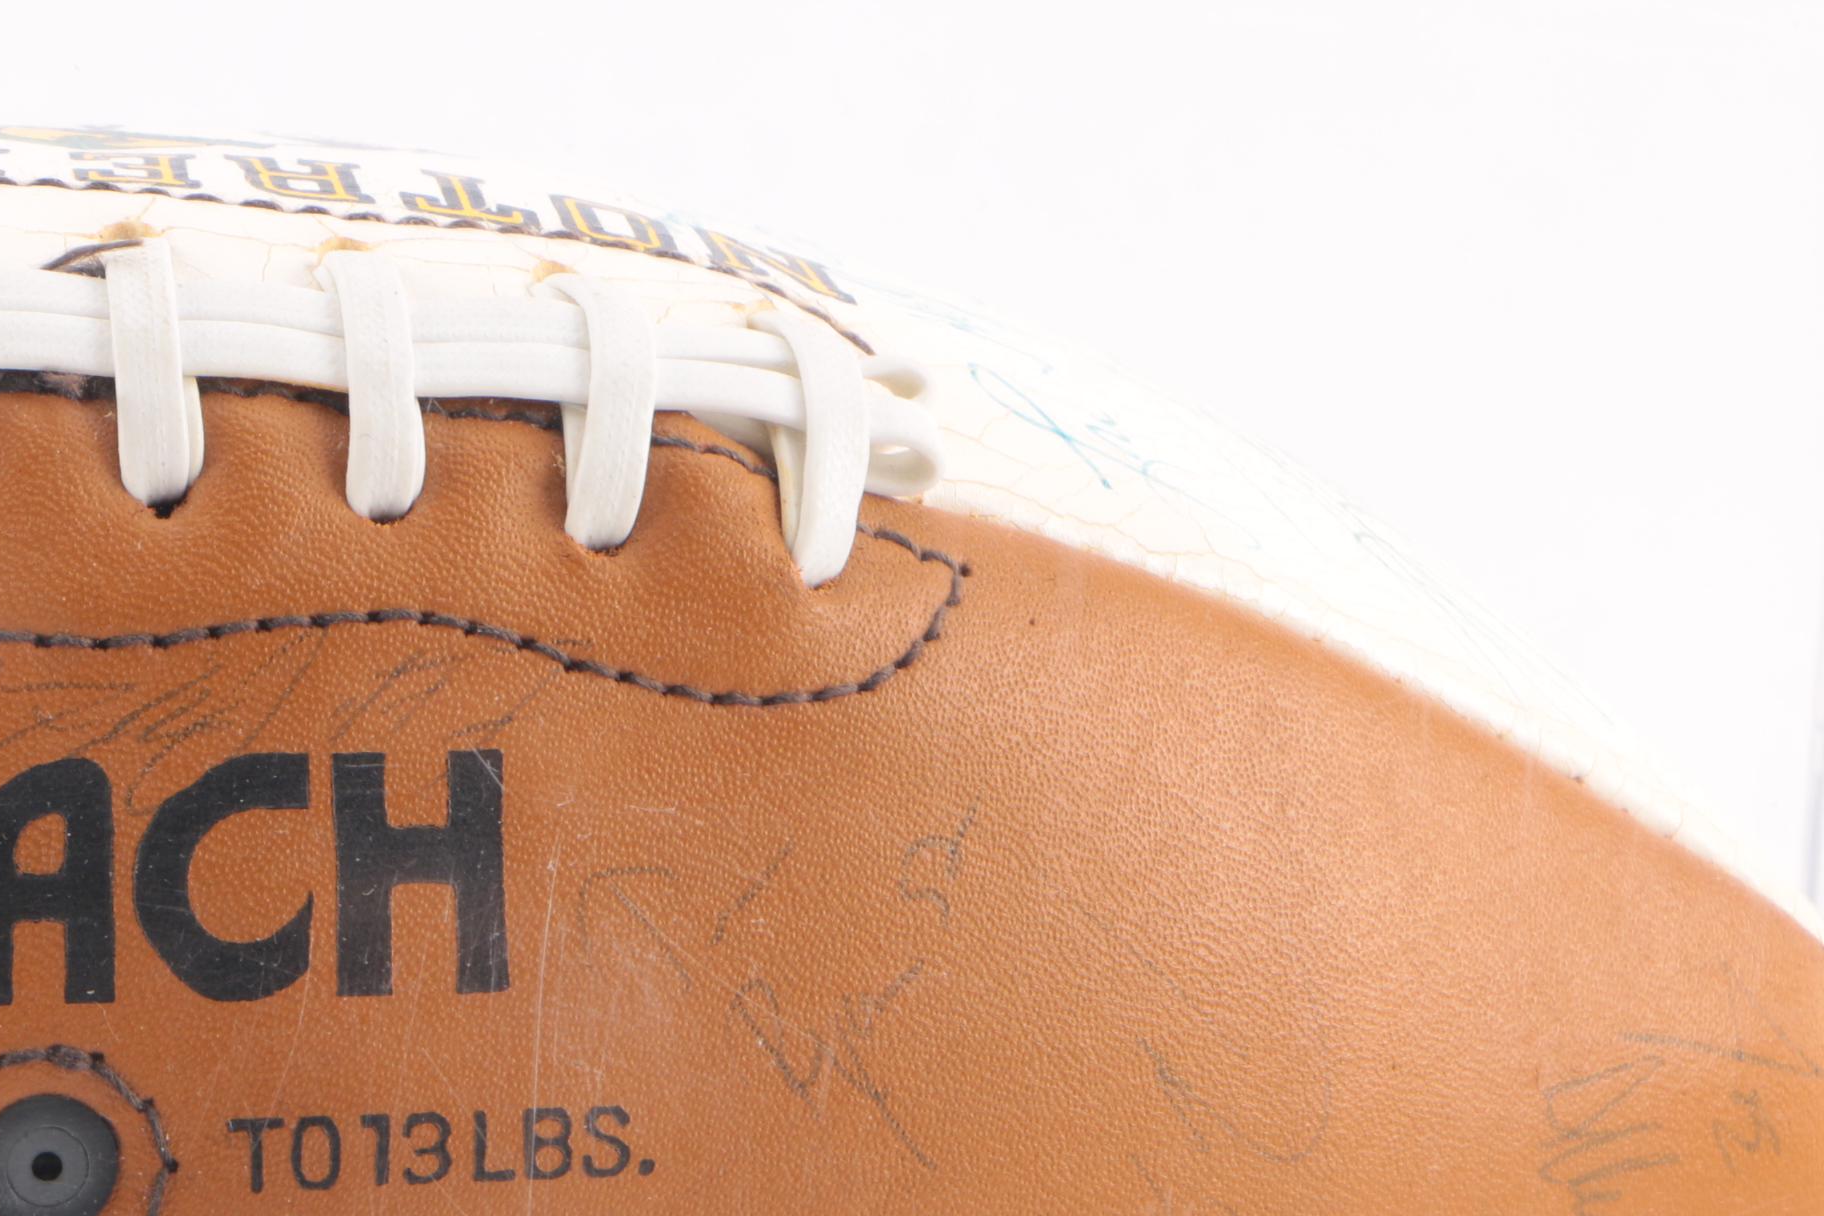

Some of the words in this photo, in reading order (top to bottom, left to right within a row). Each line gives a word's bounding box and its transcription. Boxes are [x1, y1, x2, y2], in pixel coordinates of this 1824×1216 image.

[67, 148, 857, 303] NOTRE
[227, 1115, 342, 1194] TO
[361, 1112, 452, 1187] 13
[471, 1104, 657, 1183] LBS.
